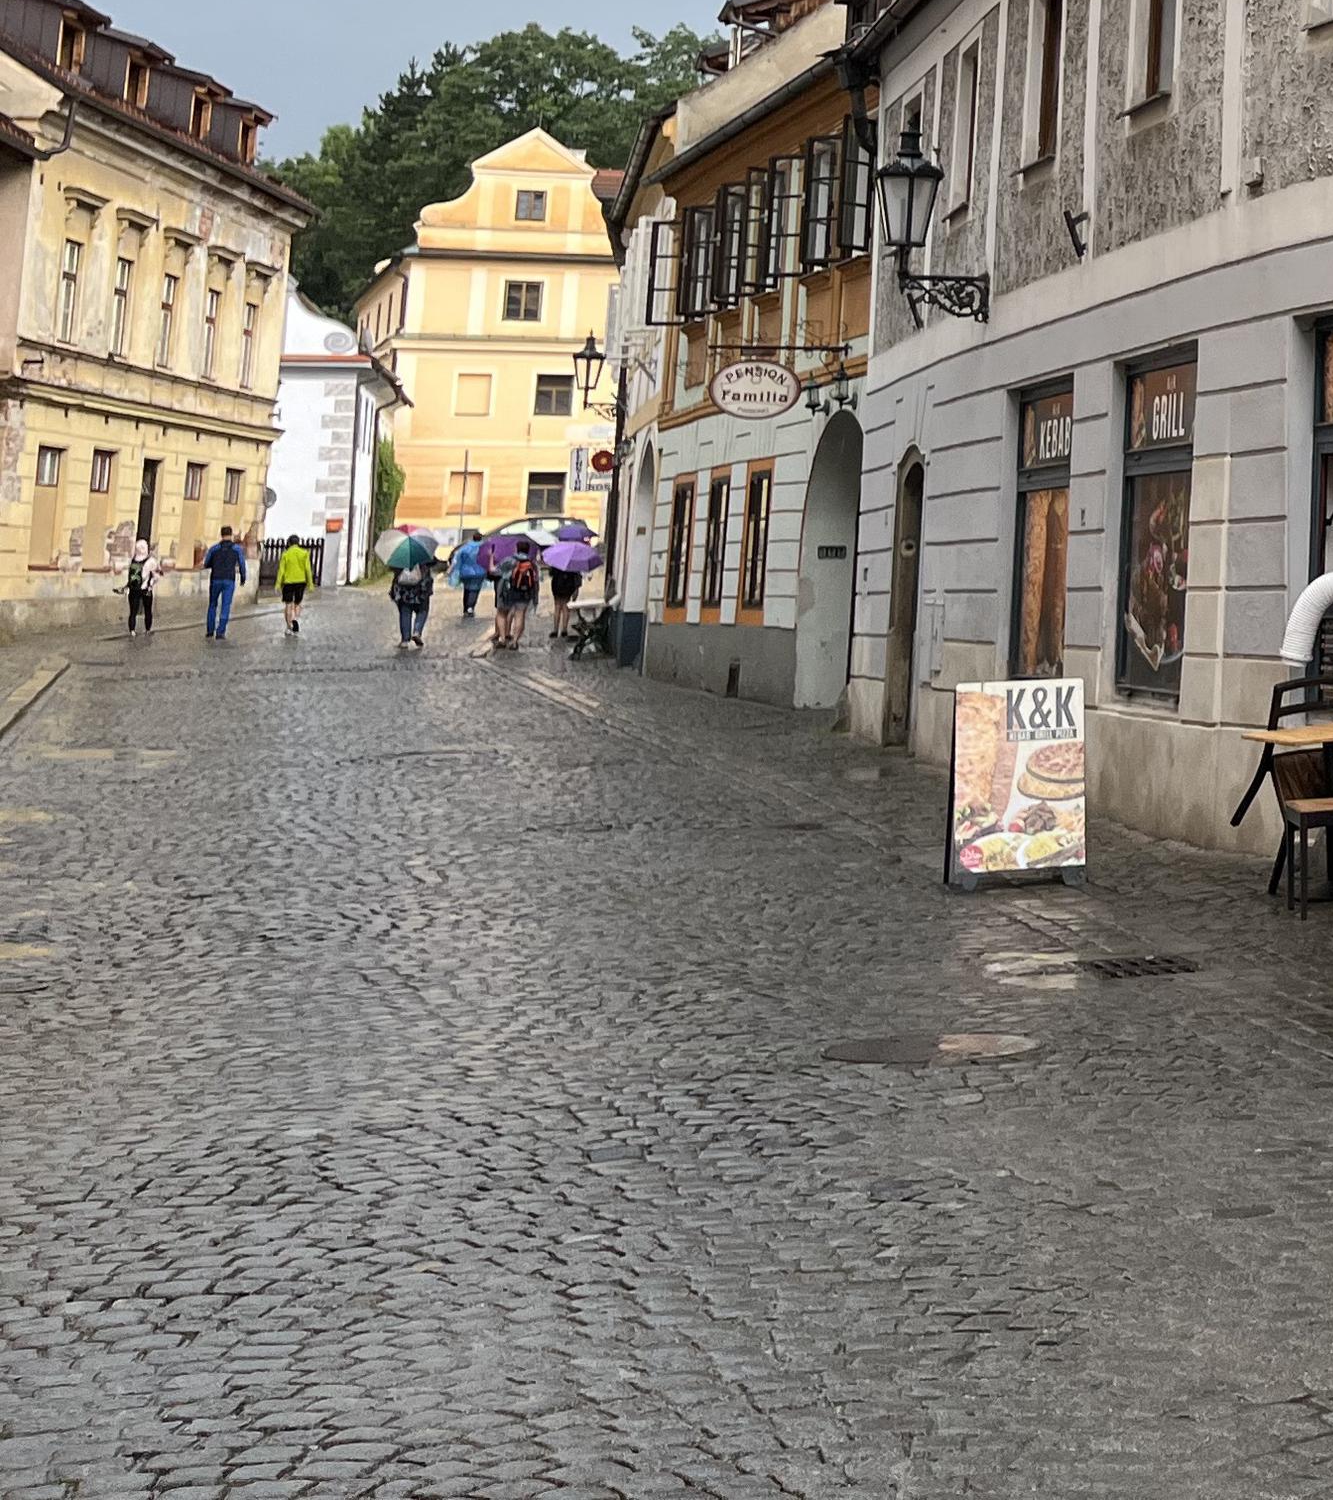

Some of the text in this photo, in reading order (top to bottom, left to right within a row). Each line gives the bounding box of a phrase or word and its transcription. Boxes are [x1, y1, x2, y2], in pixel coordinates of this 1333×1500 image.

[725, 365, 788, 385] PENSION
[1152, 391, 1185, 440] GRILL
[1039, 416, 1072, 460] KEBAB
[1006, 686, 1075, 729] K&K
